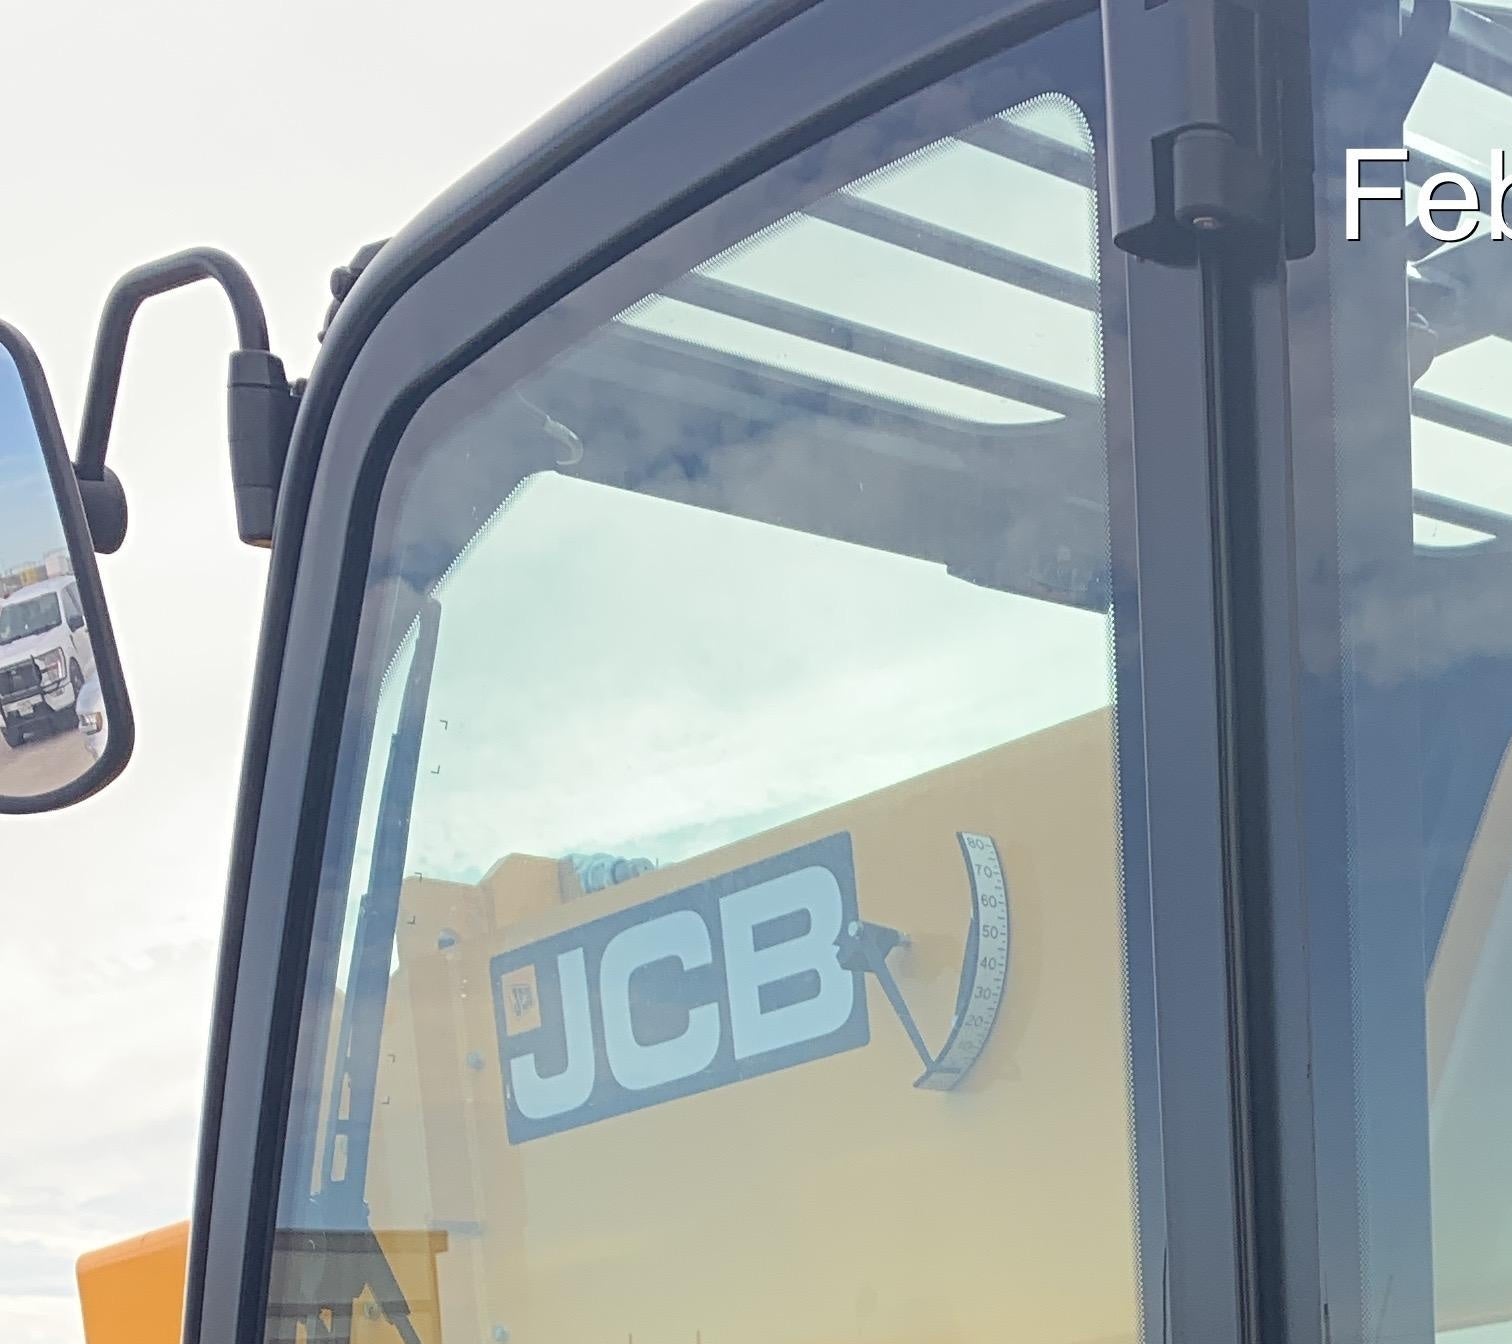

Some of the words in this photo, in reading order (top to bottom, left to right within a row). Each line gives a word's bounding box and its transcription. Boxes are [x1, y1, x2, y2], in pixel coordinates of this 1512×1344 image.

[966, 836, 985, 851] 80
[975, 864, 993, 879] 70
[981, 894, 998, 908] 60
[982, 925, 998, 940] 50
[980, 956, 997, 970] 40
[509, 864, 854, 1120] JCB
[974, 986, 991, 1000] 30
[965, 1014, 984, 1028] 20
